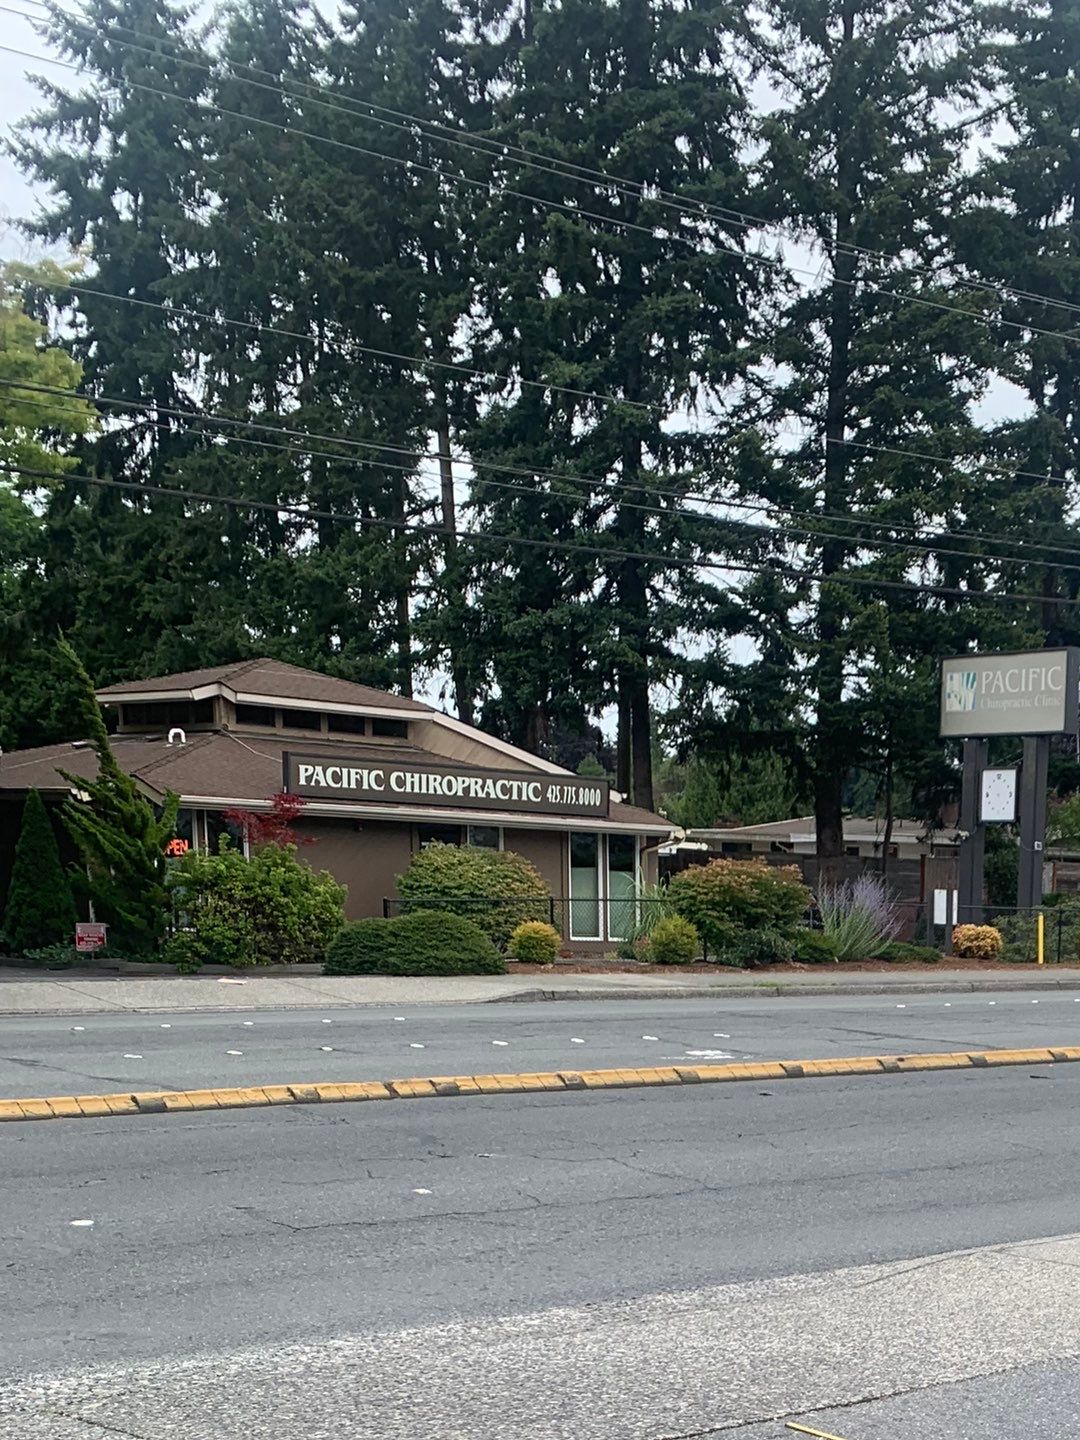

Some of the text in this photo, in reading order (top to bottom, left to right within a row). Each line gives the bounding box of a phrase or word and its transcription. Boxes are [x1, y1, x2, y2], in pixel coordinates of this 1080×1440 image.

[981, 666, 1063, 694] PACIFIC
[298, 764, 601, 806] PACIFIC CHIROPRACTIC 425.775.8000
